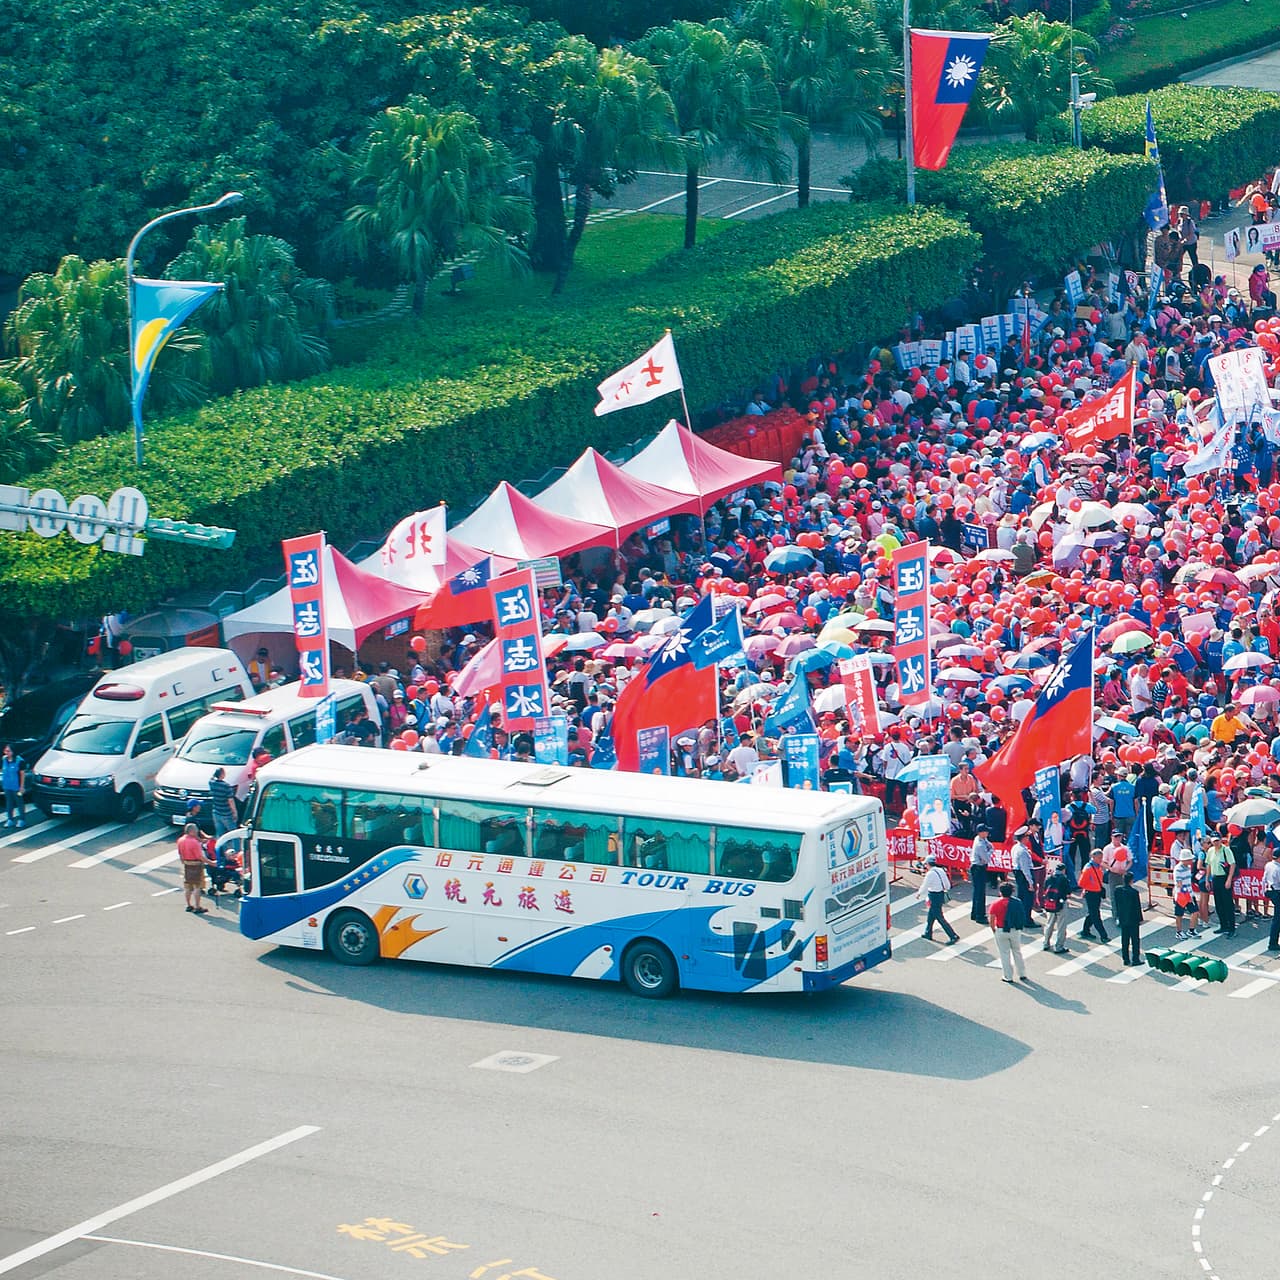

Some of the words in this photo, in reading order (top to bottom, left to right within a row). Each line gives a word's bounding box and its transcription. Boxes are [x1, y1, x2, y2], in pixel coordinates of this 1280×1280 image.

[435, 852, 608, 884] 伯元通運公司
[621, 871, 689, 891] TOUR
[702, 879, 757, 898] BUS
